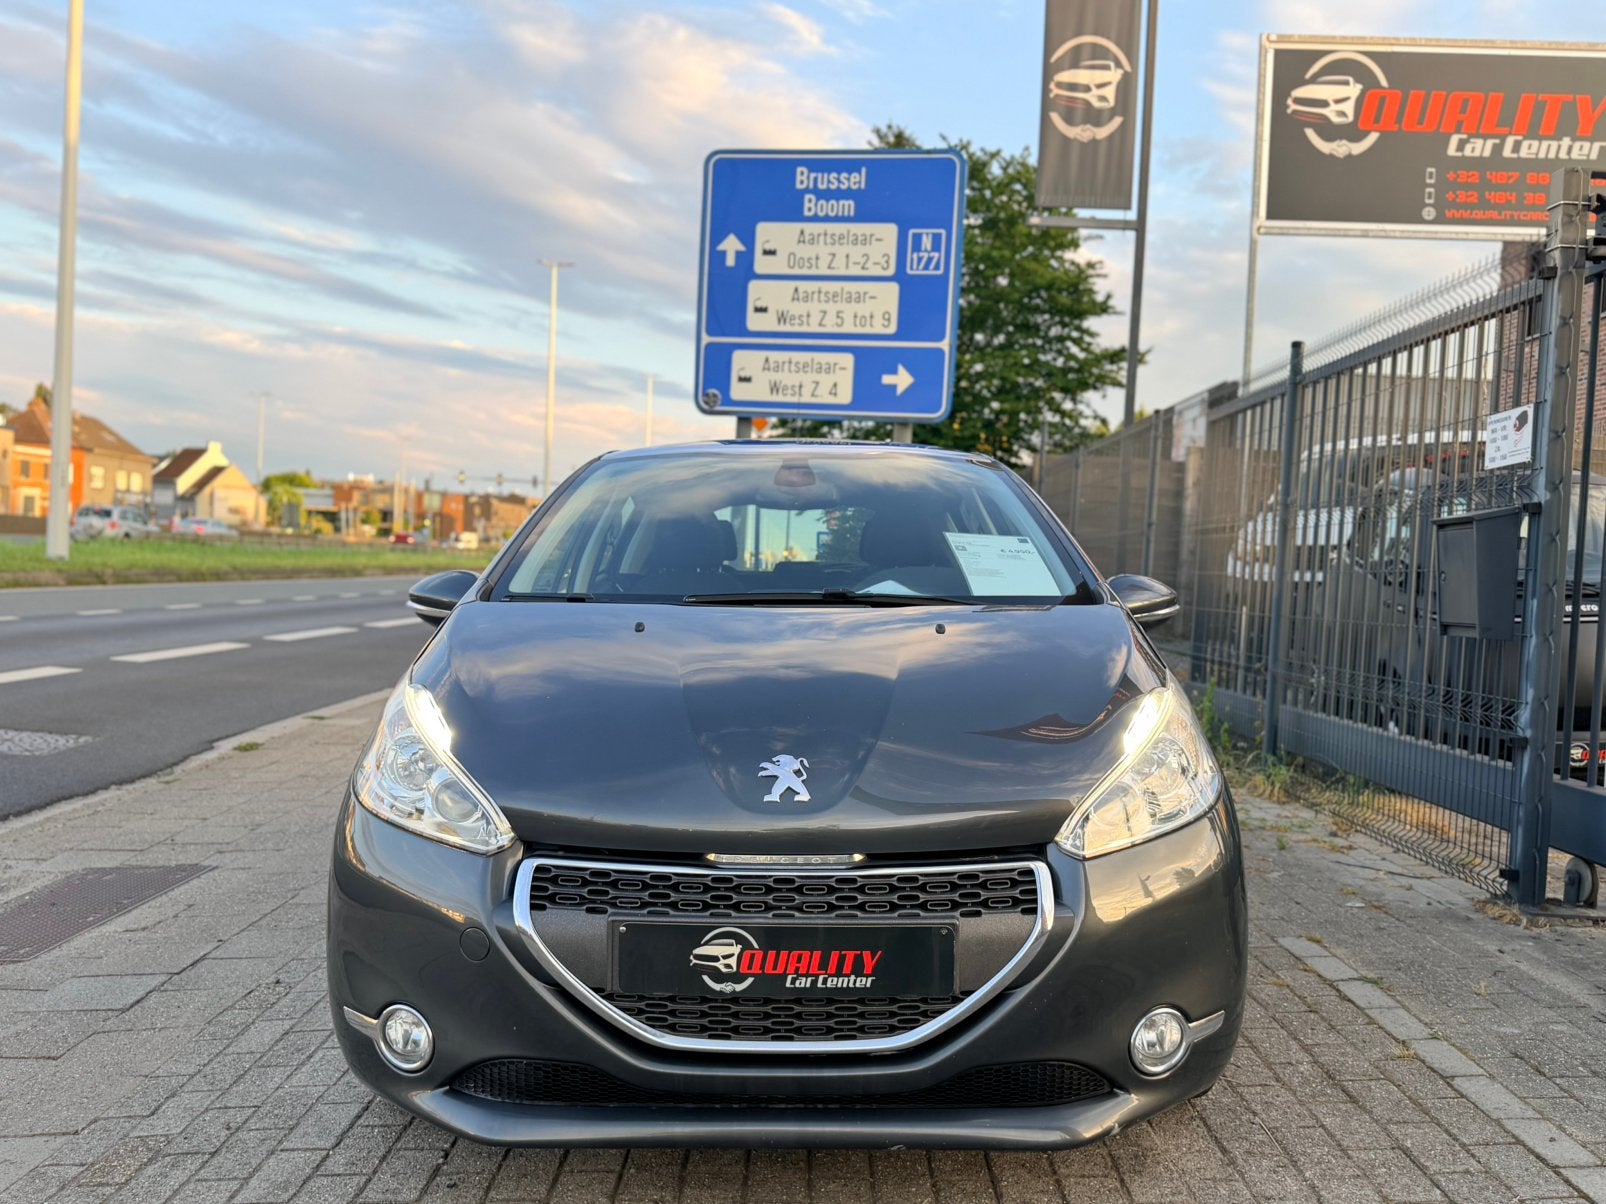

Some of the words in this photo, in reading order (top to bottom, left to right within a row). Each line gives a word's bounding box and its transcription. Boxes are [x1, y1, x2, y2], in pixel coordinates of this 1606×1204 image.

[1358, 89, 1606, 136] QUALITY
[1447, 134, 1499, 158] Car
[1502, 135, 1606, 160] Center
[795, 167, 867, 190] Brussel
[1446, 170, 1480, 184] +32
[803, 193, 856, 217] Boom
[1446, 191, 1479, 204] +32
[797, 229, 884, 246] Aartselaar-
[922, 233, 932, 251] N
[787, 253, 820, 270] Oost
[912, 252, 940, 270] 177
[791, 286, 878, 304] Aartselaar-
[776, 311, 811, 326] West
[853, 311, 874, 328] tot
[882, 311, 892, 328] 9
[762, 356, 847, 374] Aartselaar-
[769, 379, 804, 397] West
[739, 950, 882, 975] QUALITY
[785, 974, 815, 988] Car
[817, 975, 876, 988] Center
